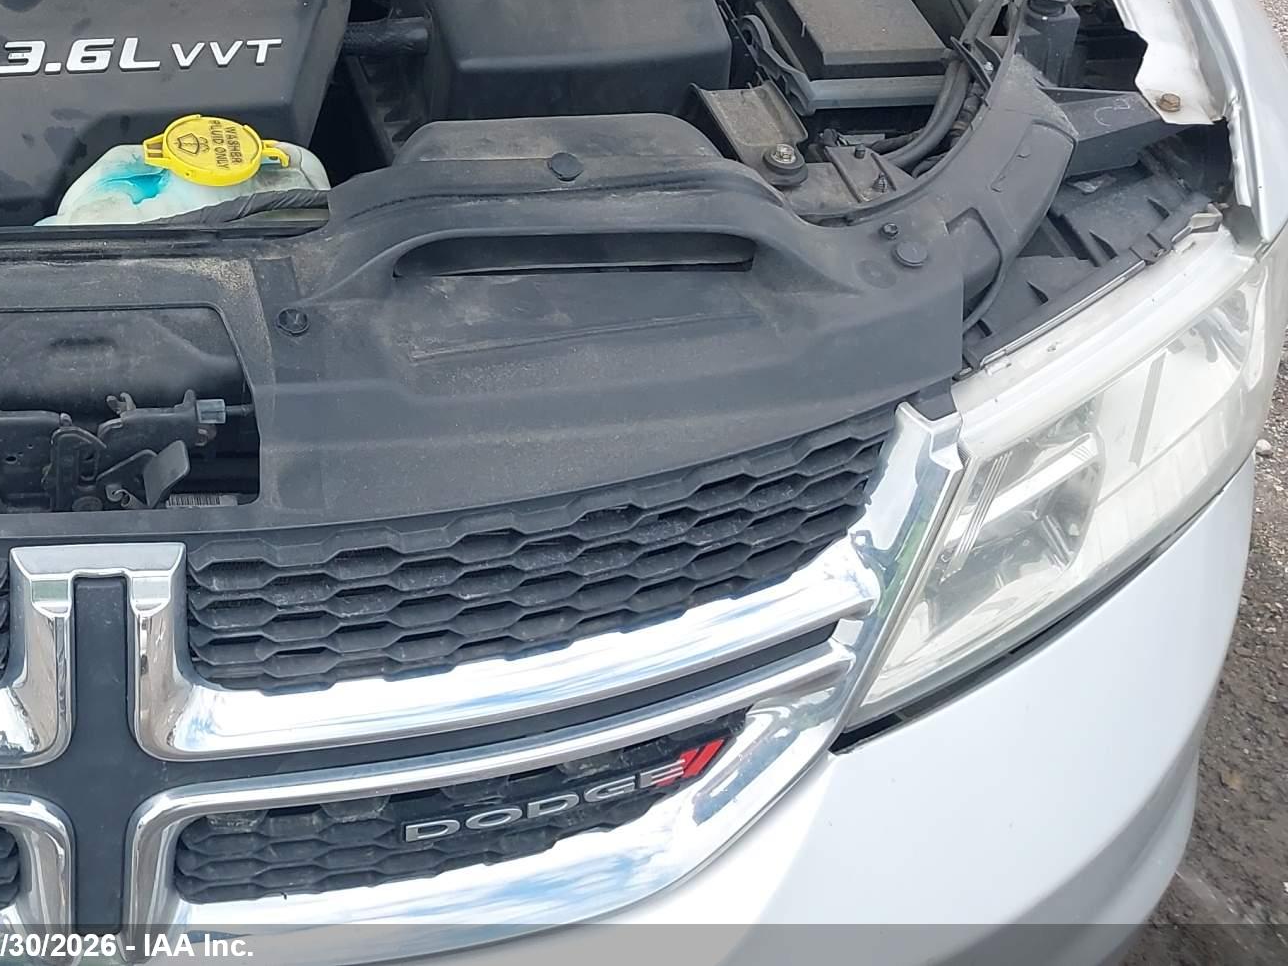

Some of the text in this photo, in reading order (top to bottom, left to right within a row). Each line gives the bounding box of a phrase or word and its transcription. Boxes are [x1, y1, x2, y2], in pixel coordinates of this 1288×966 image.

[171, 37, 284, 68] VVT
[208, 119, 230, 170] FLUID ONLY
[224, 126, 243, 165] WASHER
[402, 758, 687, 843] DODGE
